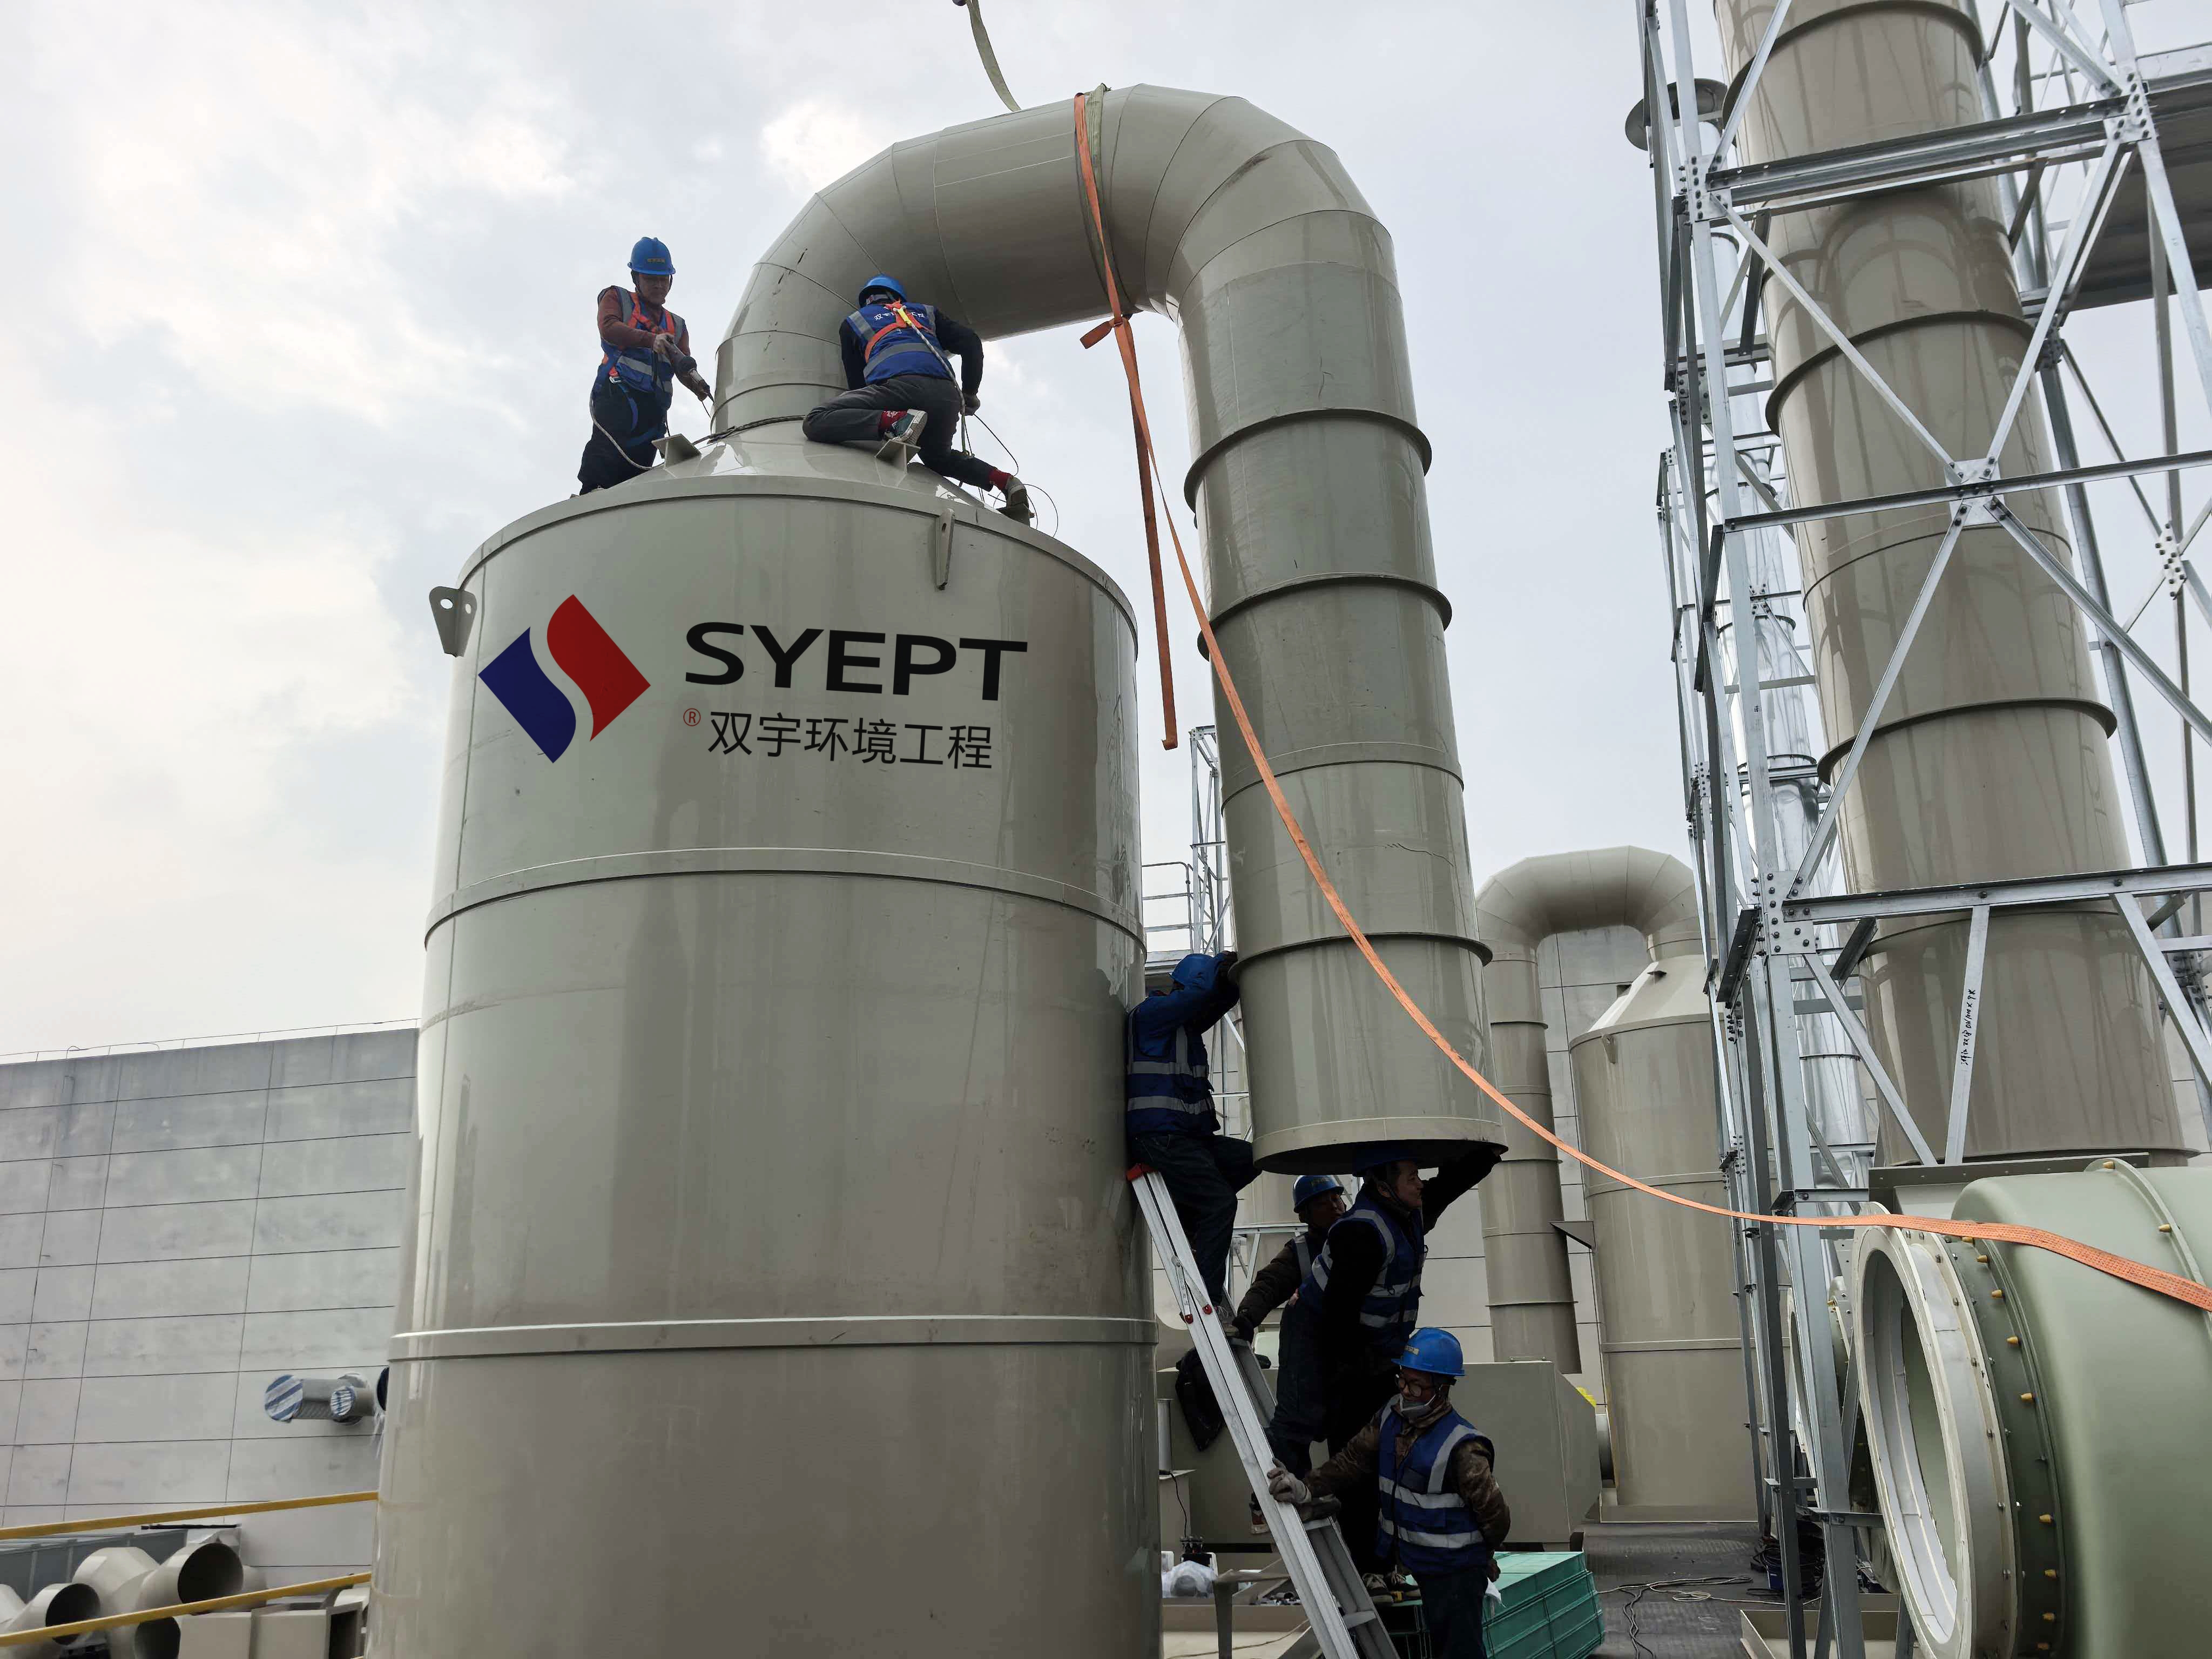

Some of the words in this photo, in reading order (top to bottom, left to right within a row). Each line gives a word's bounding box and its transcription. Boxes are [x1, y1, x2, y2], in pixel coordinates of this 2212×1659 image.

[685, 622, 1028, 701] SYEPT
[707, 711, 993, 770] 双宇环境工程
